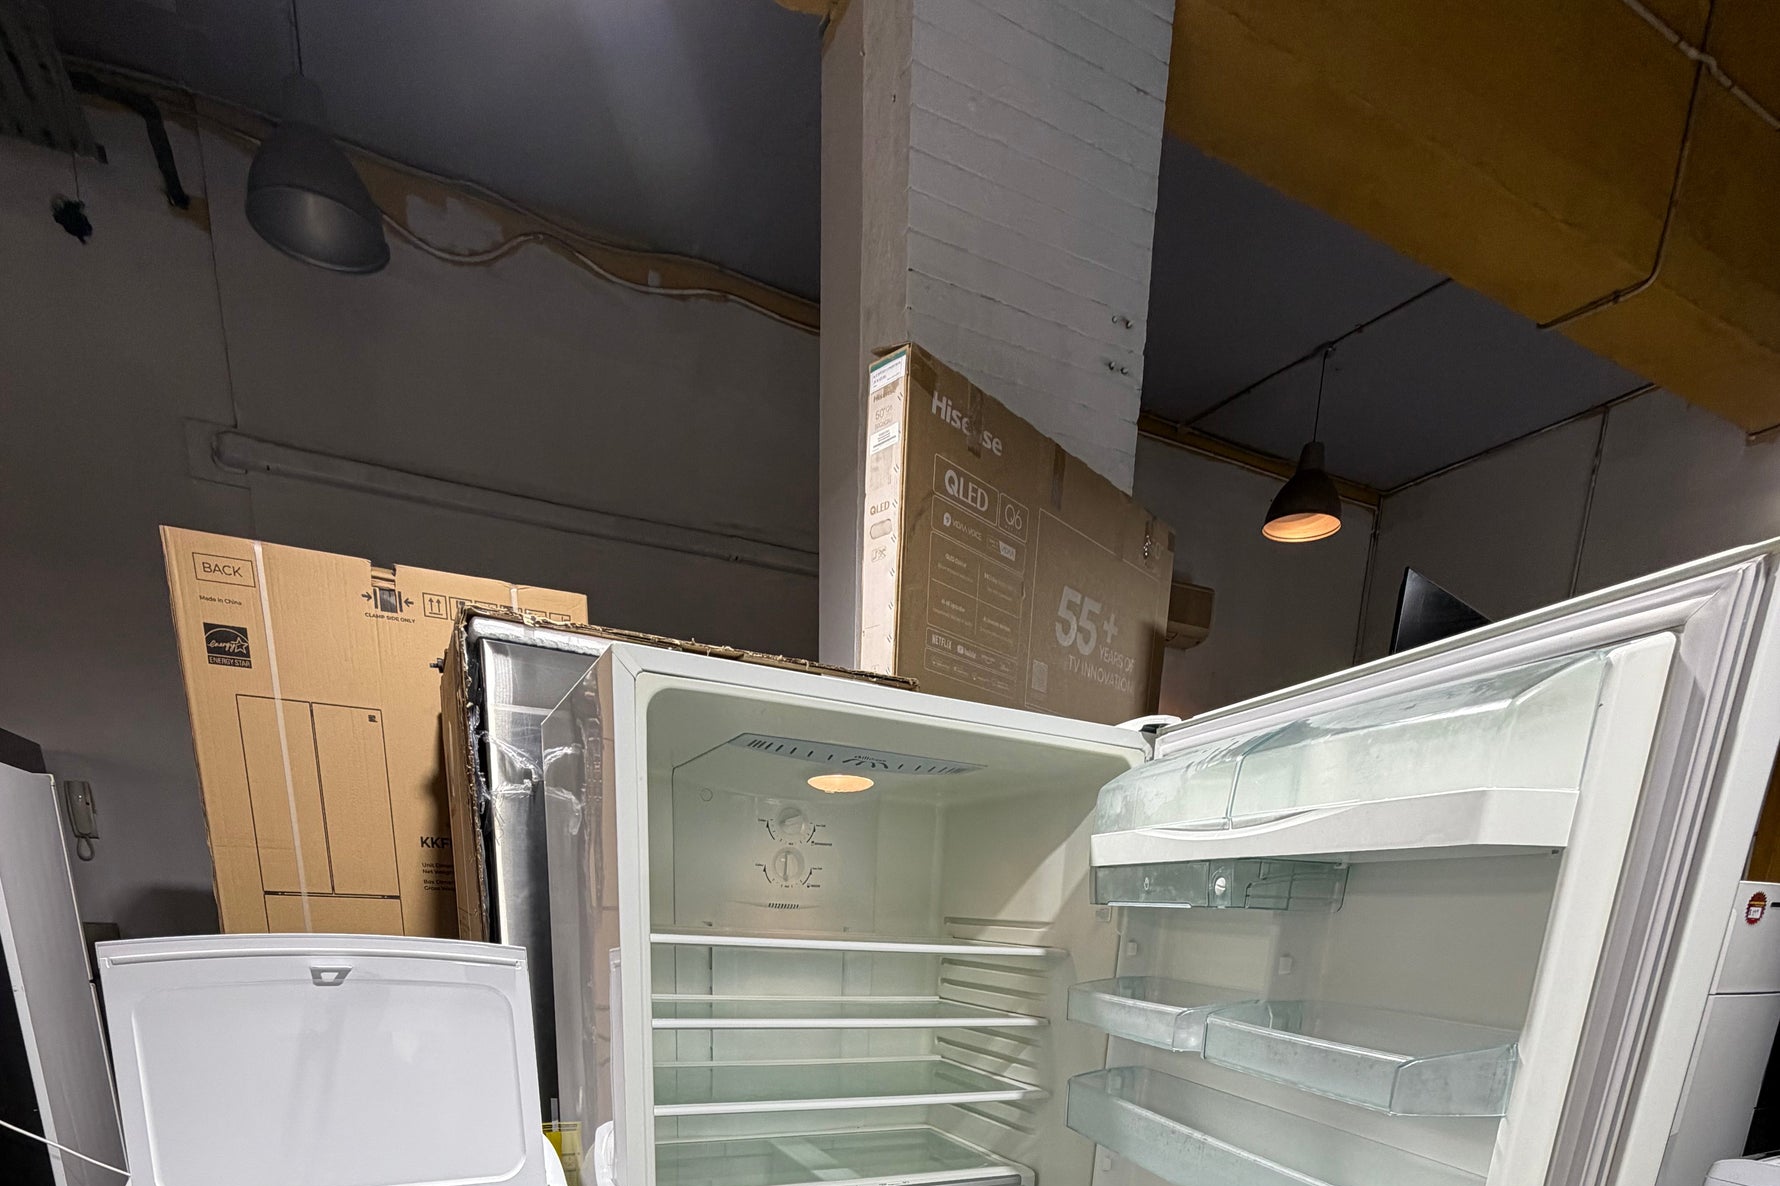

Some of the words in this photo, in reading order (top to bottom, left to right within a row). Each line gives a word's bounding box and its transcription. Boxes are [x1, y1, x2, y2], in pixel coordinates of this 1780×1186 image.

[932, 390, 1003, 456] Hisese
[944, 469, 989, 512] QLED
[869, 500, 890, 516] QLED
[1005, 504, 1023, 530] Q6
[202, 561, 243, 578] BACK
[199, 595, 216, 603] Made
[225, 598, 242, 606] China
[931, 633, 953, 650] NETFLIX
[209, 656, 233, 666] ENERGY
[234, 658, 251, 668] STAR
[1100, 644, 1124, 668] YEARS
[1123, 656, 1136, 672] OF
[1068, 655, 1081, 672] TV
[1081, 662, 1134, 694] INNOVATION
